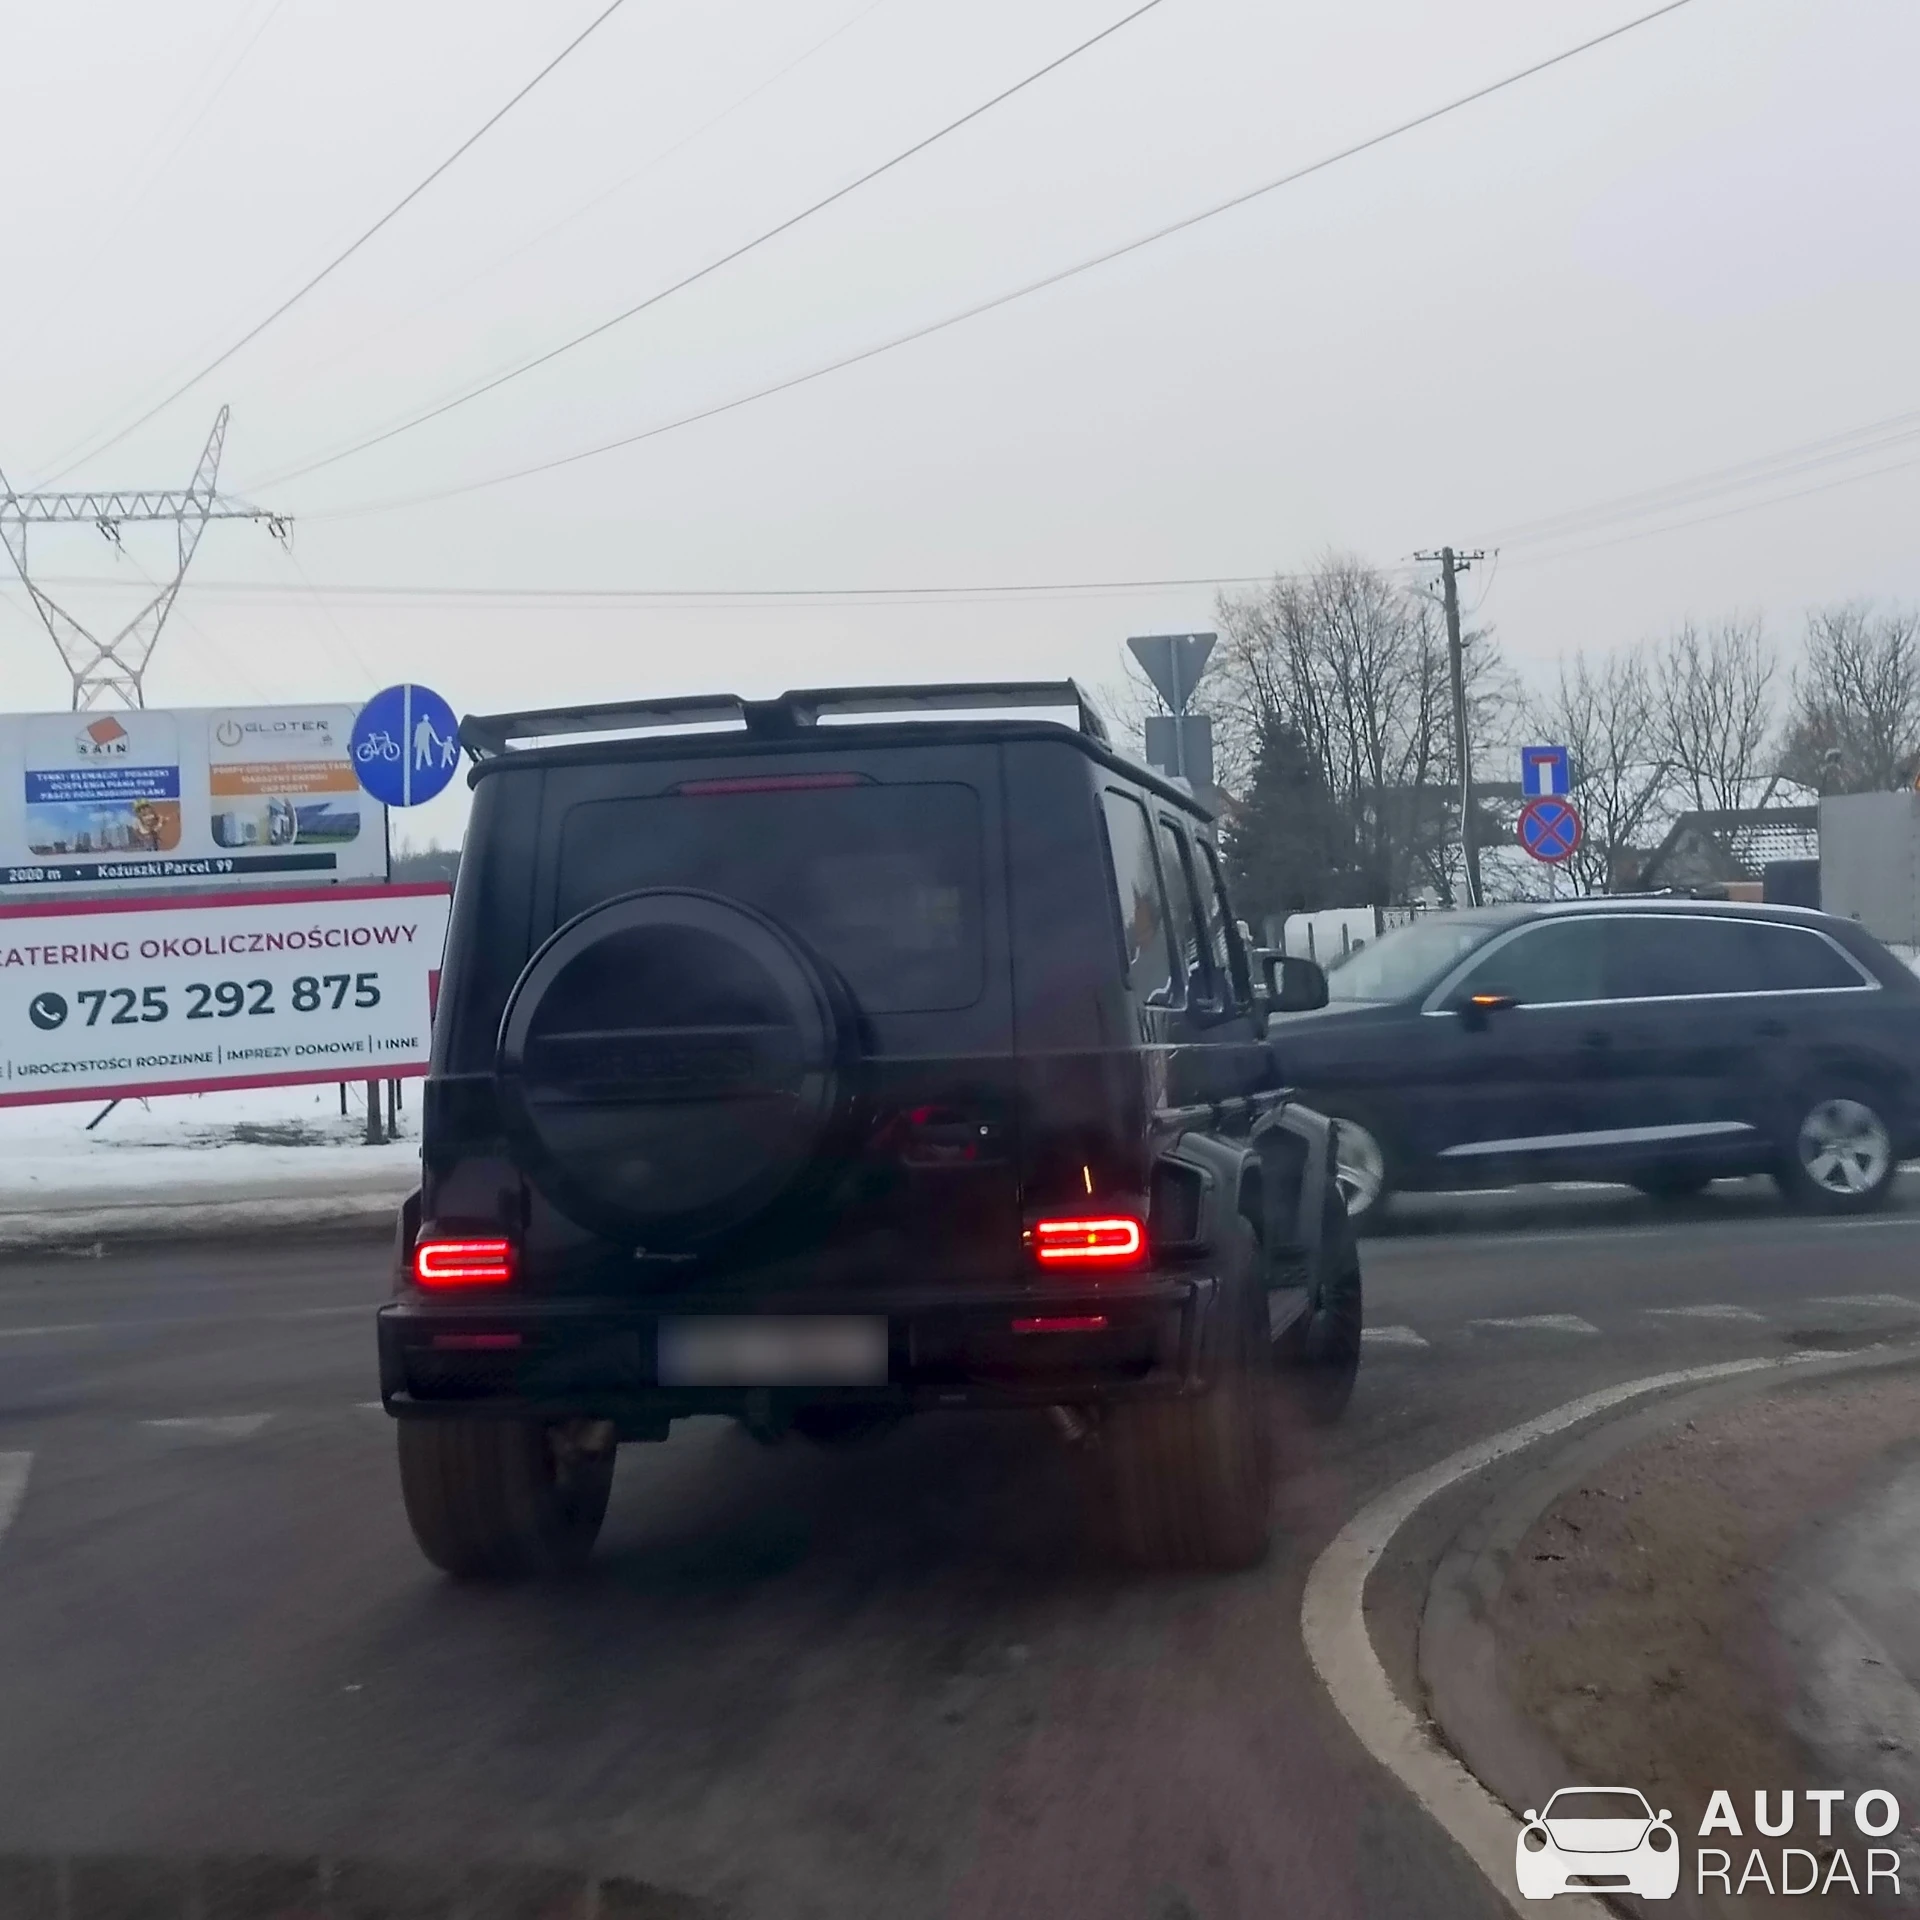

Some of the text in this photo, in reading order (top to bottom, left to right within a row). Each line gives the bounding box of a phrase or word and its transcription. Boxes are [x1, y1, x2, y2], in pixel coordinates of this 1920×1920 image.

[245, 720, 330, 733] GLOTER
[78, 743, 127, 755] SAIN
[9, 868, 44, 882] 2000
[47, 869, 62, 880] m
[164, 860, 210, 875] Parcel
[216, 859, 234, 872] 99
[0, 924, 418, 967] ATERING OKOLICZNOŚCIOWY
[78, 972, 381, 1026] 725 292 875
[17, 1057, 133, 1077] UROCZYSTOŚCI
[136, 1051, 213, 1067] RODZINNE
[227, 1045, 291, 1061] IMPREZY
[295, 1040, 364, 1056] DOMOWE
[386, 1037, 419, 1049] INNE
